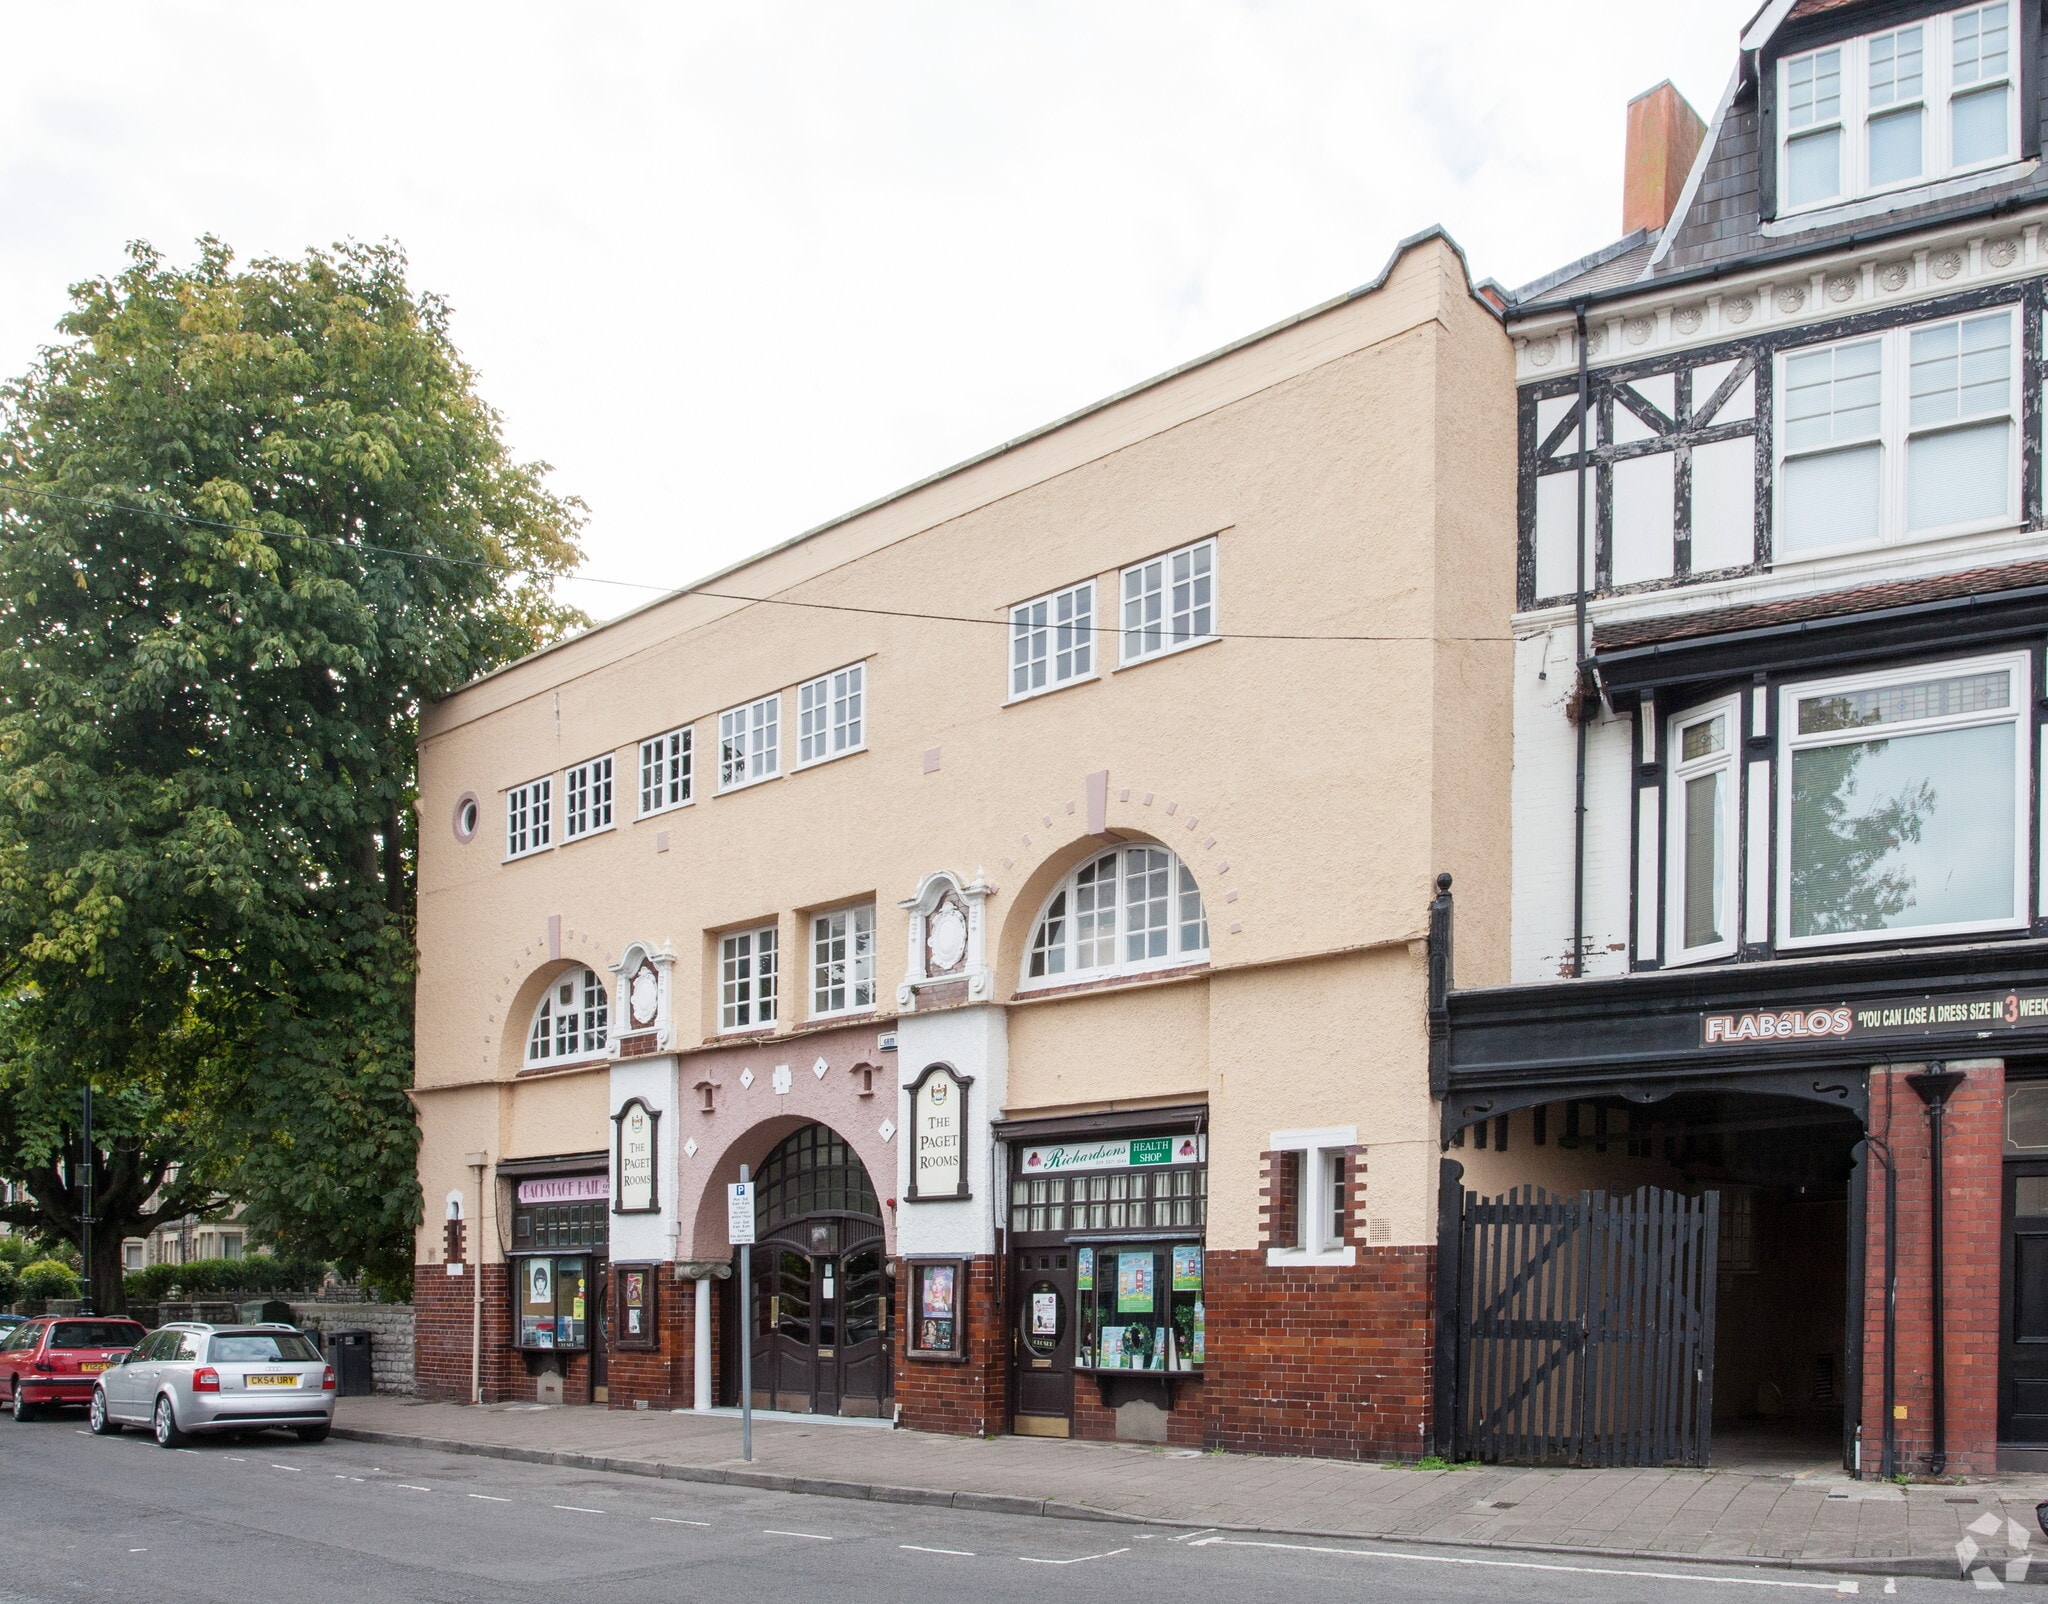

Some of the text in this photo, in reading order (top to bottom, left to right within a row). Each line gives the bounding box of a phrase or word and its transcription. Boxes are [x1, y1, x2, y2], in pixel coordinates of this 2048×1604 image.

[1882, 1009, 1902, 1026] CAN
[1903, 1006, 1927, 1024] LOSE
[1928, 1006, 1936, 1023] A
[1937, 1004, 1968, 1022] DRESS
[1969, 1002, 1991, 1020] SIZE
[1992, 1001, 2003, 1018] IN
[2004, 995, 2018, 1023] 3
[1706, 1009, 1850, 1040] FLABéLOS
[928, 1116, 950, 1129] THE
[629, 1142, 645, 1153] THE
[920, 1134, 958, 1150] PAGET
[1133, 1140, 1169, 1152] HEALTH
[920, 1155, 959, 1169] ROOMS
[1044, 1144, 1126, 1170] Richardsons
[1139, 1152, 1162, 1163] SHOP
[624, 1158, 650, 1171] PAGET
[624, 1175, 651, 1187] ROOMS
[523, 1181, 574, 1198] BACKSTAGE
[577, 1179, 601, 1196] HAIR
[738, 1186, 744, 1195] P
[251, 1375, 296, 1385] CK54 URY
